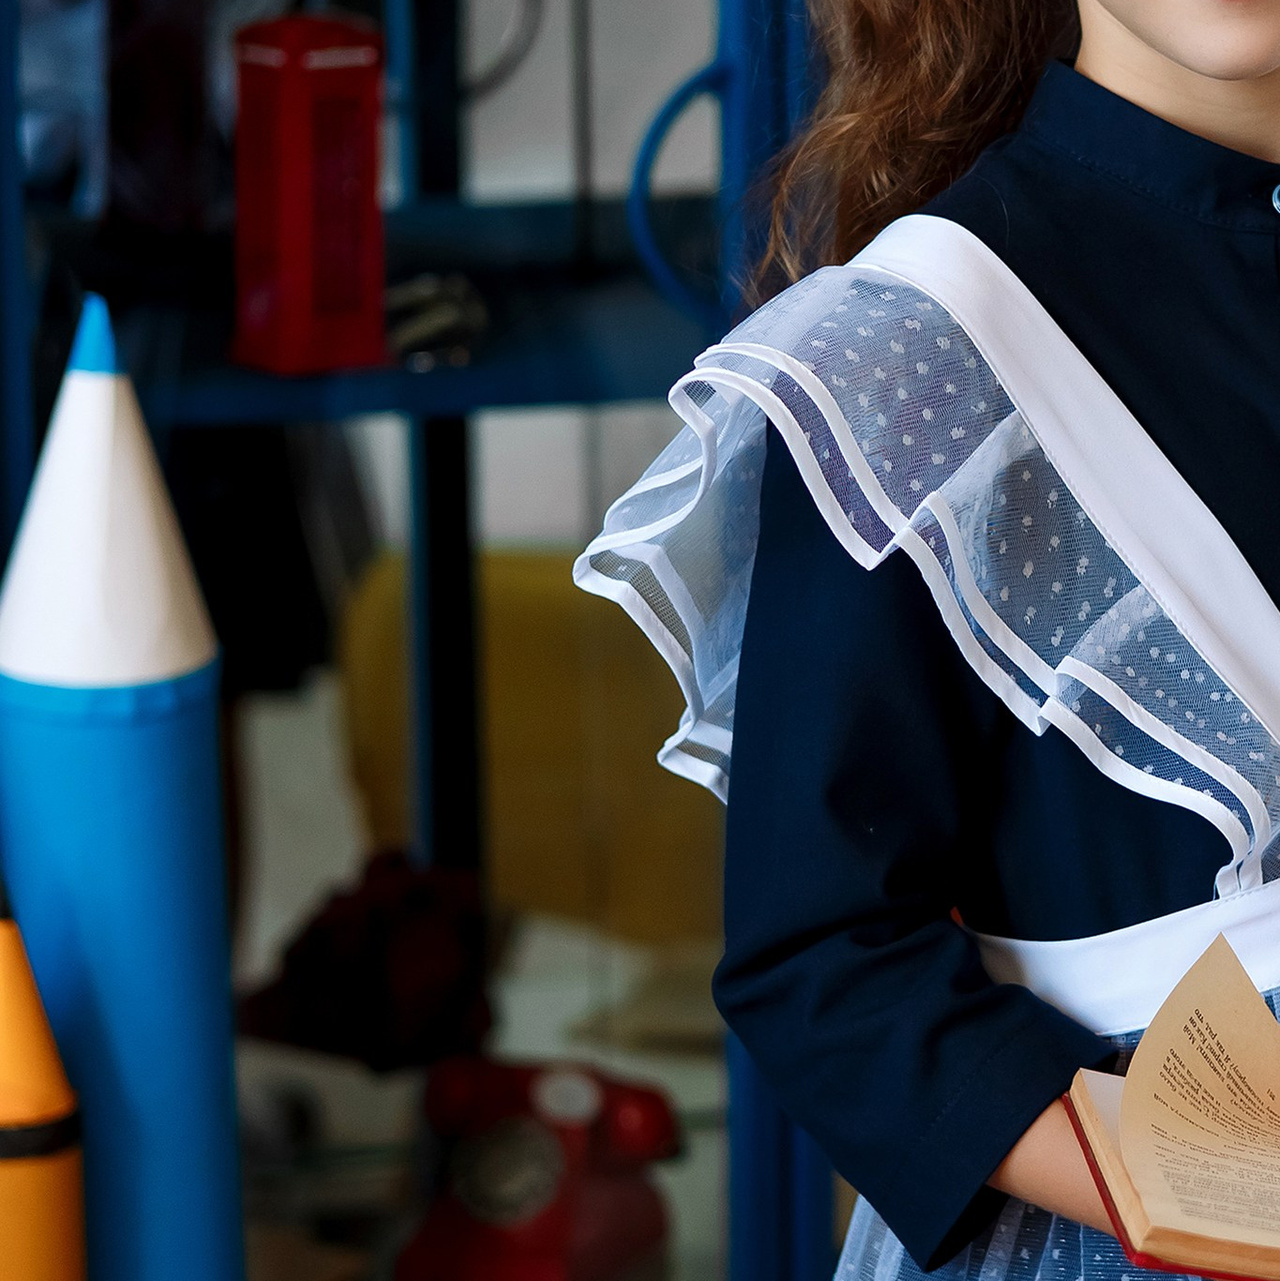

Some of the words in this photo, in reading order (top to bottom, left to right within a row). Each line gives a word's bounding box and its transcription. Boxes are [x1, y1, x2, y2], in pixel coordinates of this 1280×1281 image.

[1188, 1015, 1198, 1029] он
[1193, 1008, 1205, 1024] что
[1182, 1023, 1197, 1046] Мой
[1194, 1025, 1209, 1046] Как
[1204, 1041, 1228, 1073] старик!
[1214, 1039, 1226, 1056] так
[1158, 1070, 1178, 1093] было
